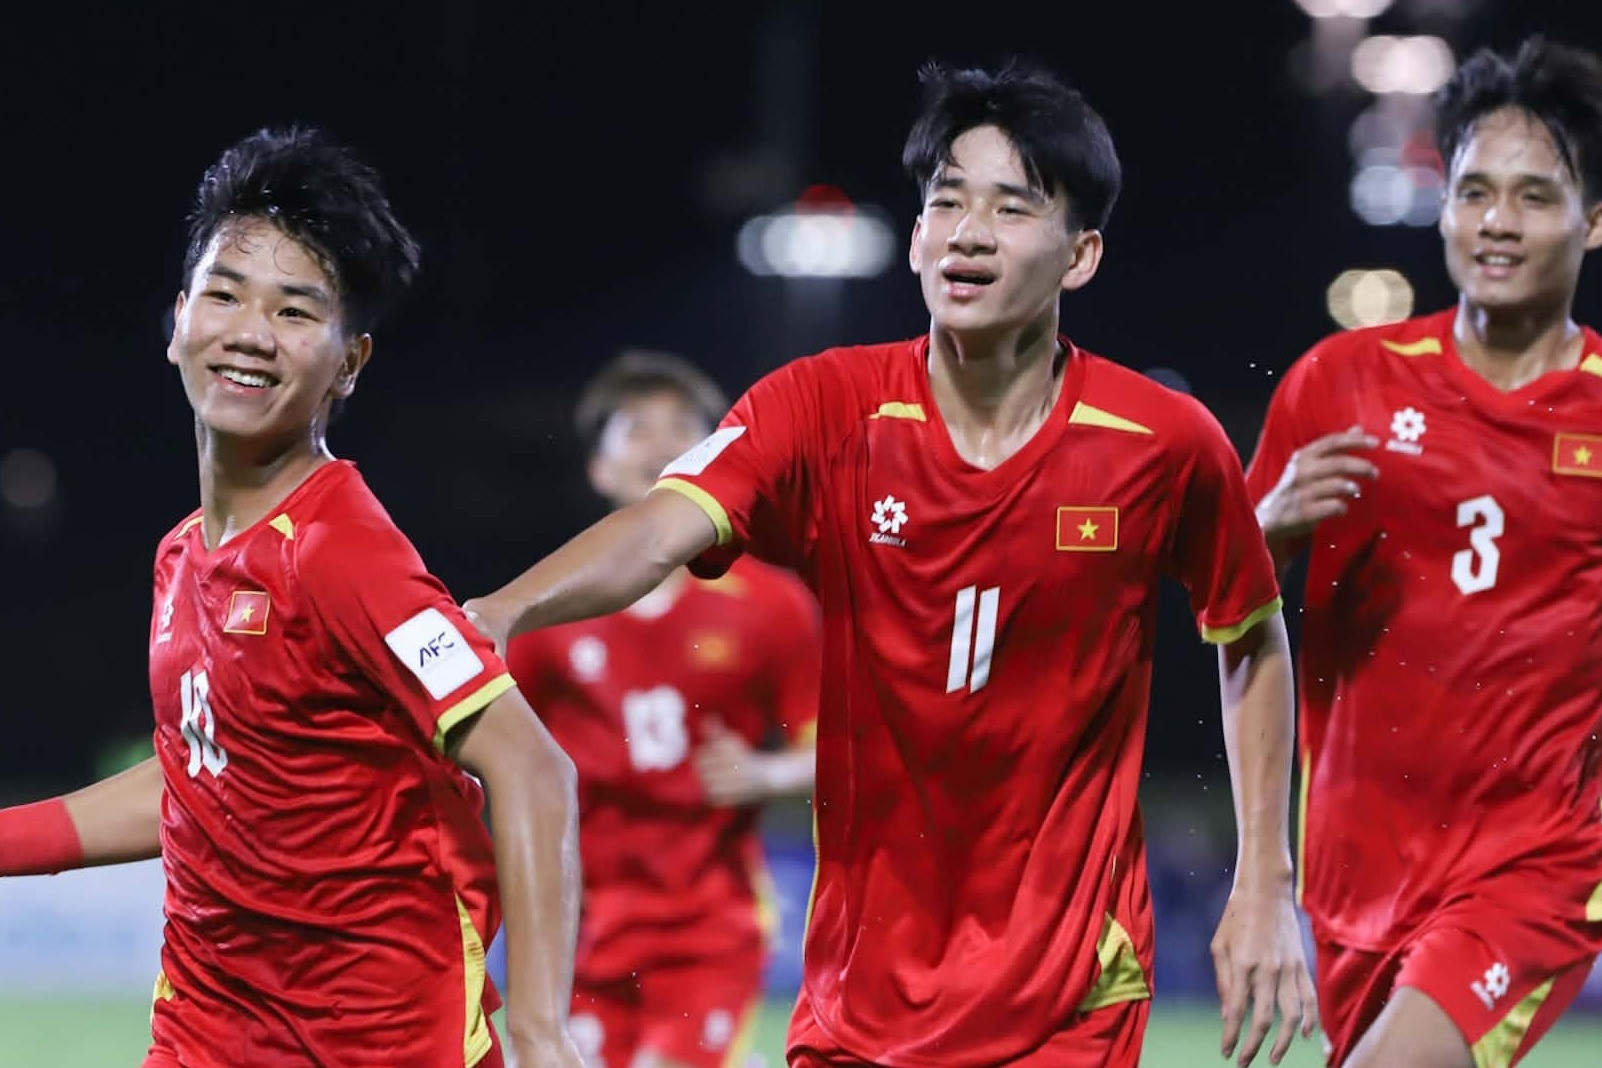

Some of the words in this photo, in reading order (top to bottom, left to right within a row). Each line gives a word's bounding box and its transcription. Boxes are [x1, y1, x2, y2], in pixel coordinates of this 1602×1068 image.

[1451, 495, 1504, 596] 3
[419, 631, 455, 667] AFC
[946, 585, 1000, 693] 11
